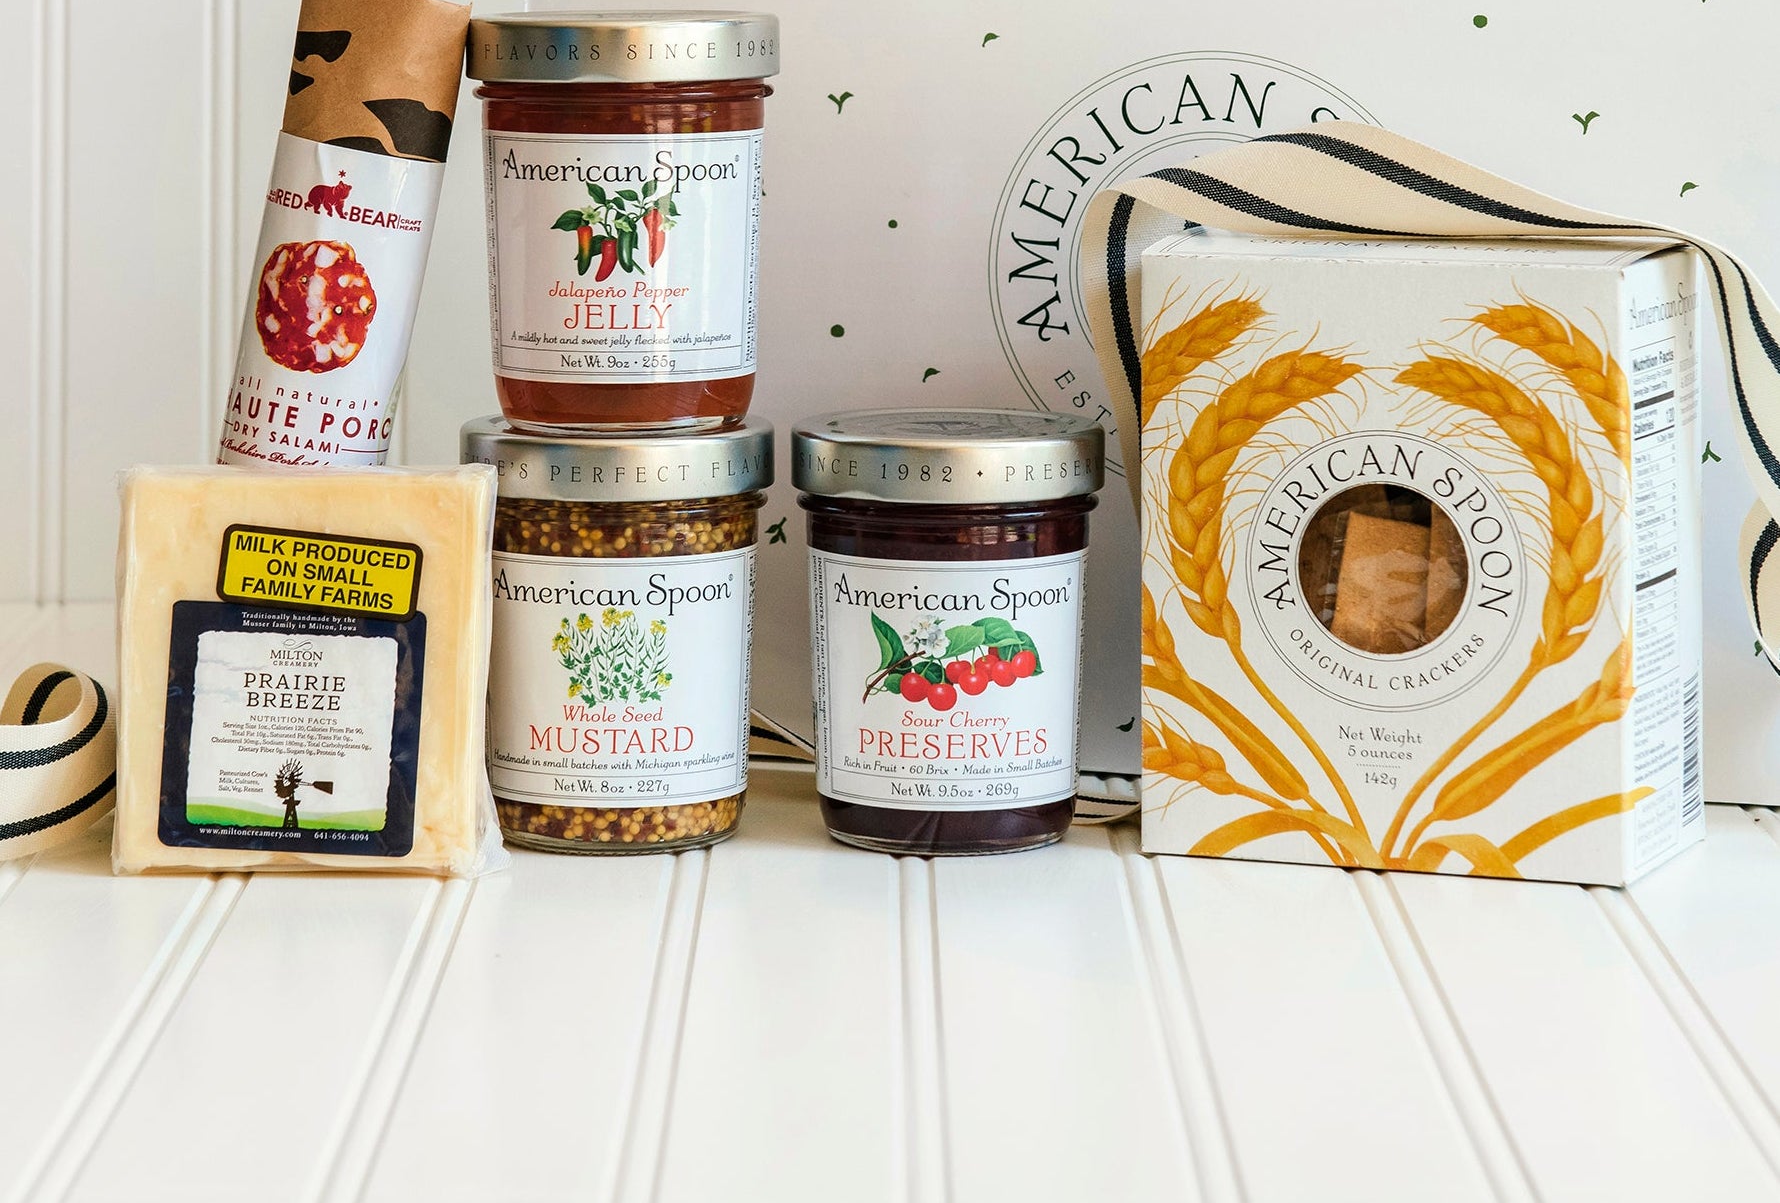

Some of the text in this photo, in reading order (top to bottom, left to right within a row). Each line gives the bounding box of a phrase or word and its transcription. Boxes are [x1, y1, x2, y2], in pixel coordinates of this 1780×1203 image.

[484, 39, 774, 61] FLAVORS SINCE 1982
[502, 149, 648, 183] American
[275, 188, 303, 210] RED
[348, 206, 398, 229] BEAR
[1008, 72, 1276, 343] AMERICAN
[399, 218, 422, 227] CRAFT
[548, 280, 689, 303] Jalapeño Pepper
[563, 303, 673, 330] JELLY
[511, 331, 517, 341] A
[518, 331, 541, 344] mildly
[543, 333, 557, 344] hot
[559, 334, 579, 345] and
[581, 336, 607, 345] sweet
[609, 334, 632, 348] jelly
[634, 334, 669, 346] flecked
[671, 333, 692, 344] with
[560, 354, 676, 372] Net Wt. 9oz 255g
[239, 376, 261, 390] all
[233, 420, 340, 455] DRY SALAMI
[550, 464, 691, 484] PERFECT
[799, 452, 859, 477] SINCE
[880, 463, 954, 483] 1982
[1258, 442, 1424, 611] AMERICAN
[1432, 466, 1514, 619] SPOON
[235, 534, 411, 571] MILK PRODUCED
[266, 558, 374, 587] ON SMALL
[241, 576, 394, 610] FAMILY FARMS
[494, 568, 641, 607] American
[834, 572, 984, 612] American
[242, 611, 356, 624] Traditionally handmade by the
[242, 619, 357, 632] Musser family in Milton, Iowa
[270, 648, 323, 662] MILTON
[273, 660, 319, 668] CREAMERY
[1290, 628, 1486, 692] ORIGINAL CRACKERS
[243, 671, 346, 693] PRAIRIE
[246, 691, 341, 711] BREEZE
[249, 715, 338, 725] NUTRITION FACTS
[562, 704, 663, 723] Whole Seed
[901, 710, 1010, 731] Sour Cherry
[529, 724, 694, 755] MUSTARD
[858, 727, 1047, 760] PRESERVES
[1339, 724, 1422, 746] Net Weight
[1348, 745, 1413, 760] 5 ounces
[532, 757, 541, 767] in
[542, 756, 570, 769] small
[571, 757, 609, 771] batches
[610, 759, 632, 771] with
[634, 758, 680, 773] Michigan
[683, 754, 720, 771] sparkling
[843, 755, 1063, 776] Rich in Fruit 60 Brix Made in Small Batches
[553, 779, 670, 796] Net Wt. 8oz 227g
[890, 782, 1019, 799] Net Wt. 9.5oz 269g
[1364, 772, 1397, 789] 142g
[199, 827, 369, 842] www.miltoncreamery.com 641-656-4094
